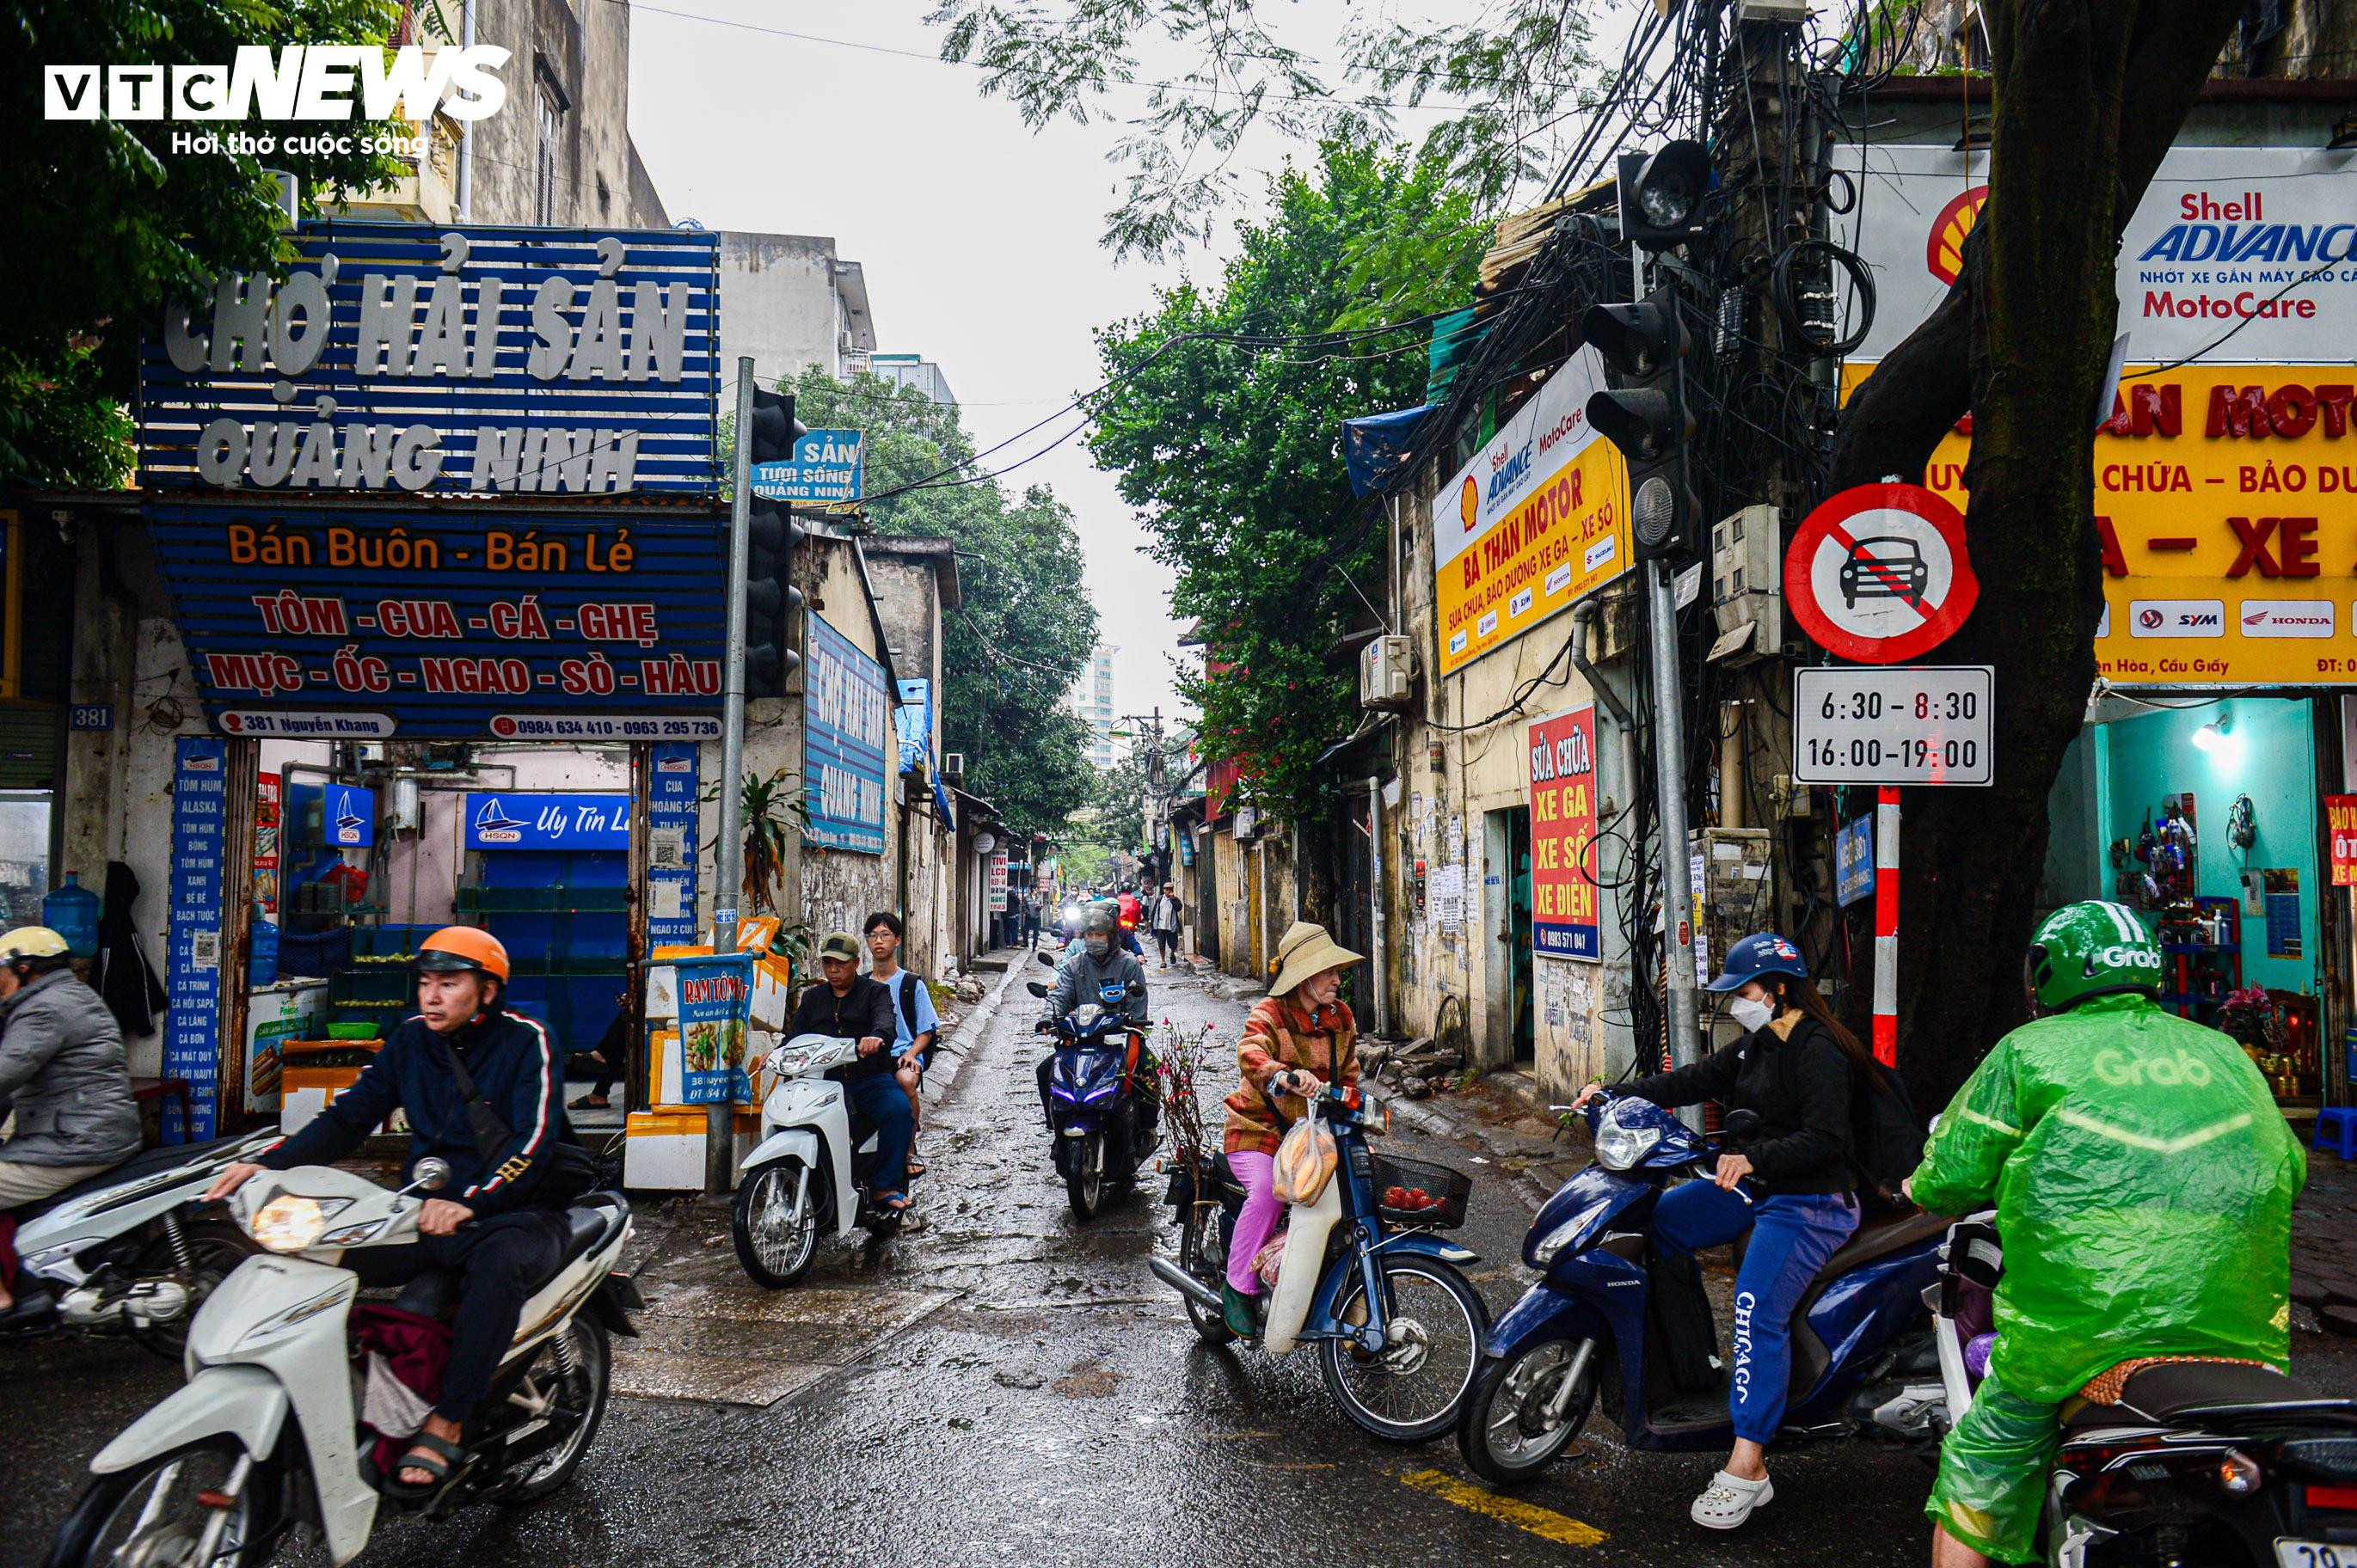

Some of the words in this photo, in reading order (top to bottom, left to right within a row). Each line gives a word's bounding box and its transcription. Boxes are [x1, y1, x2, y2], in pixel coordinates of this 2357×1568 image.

[2179, 192, 2263, 222] Shell
[2140, 267, 2185, 284] NHỚT
[2191, 271, 2211, 284] XE
[2215, 266, 2256, 284] GẮN
[2259, 267, 2295, 284] MÁY
[2301, 270, 2331, 283] CAO
[2143, 291, 2317, 319] MotoCare
[163, 252, 340, 402] CHỢ
[356, 233, 503, 378] HẢI
[526, 237, 689, 383] SẢN
[2205, 383, 2357, 438] MOT
[1538, 407, 1582, 457] MotoCare
[196, 395, 443, 490] QUẢNG
[471, 426, 641, 492] NINH
[804, 436, 856, 463] SẢN
[1492, 441, 1508, 472] Shell
[1487, 439, 1532, 505] ADVANCE
[2102, 460, 2192, 493] CHỮA
[2239, 460, 2308, 493] BẢO
[754, 483, 809, 497] QUẢNG
[814, 487, 855, 497] NINH
[1464, 543, 1481, 590] BÁ
[1483, 517, 1520, 575] THÂN
[1525, 468, 1583, 547] MOTOR
[1539, 545, 1551, 571] XE
[1554, 534, 1568, 561] GA
[1581, 513, 1594, 543] XE
[1598, 493, 1613, 531] SỐ
[228, 524, 310, 565] Bán
[328, 528, 438, 568] Buôn
[487, 531, 566, 572] Bán
[586, 528, 633, 572] Lẻ
[1595, 544, 1614, 560] SUZUKI
[2225, 516, 2320, 578] XE
[1553, 572, 1570, 586] HONDA
[252, 589, 348, 635] TÔM
[377, 600, 463, 638] CUA
[489, 595, 549, 639] CÁ
[578, 603, 658, 647] GHẸ
[2178, 615, 2217, 627] SYM
[2272, 616, 2331, 625] HONDA
[206, 652, 302, 697] MỰC
[333, 645, 390, 692] ỐC
[420, 658, 531, 695] NGAO
[560, 652, 615, 695] SÒ
[641, 653, 721, 695] HÀU
[2159, 658, 2188, 672] Cầu
[2194, 658, 2229, 675] Giấy
[2317, 658, 2342, 672] ĐT:
[819, 650, 844, 747] CHỢ
[844, 654, 863, 740] HẢI
[865, 667, 884, 750] SẢN
[1821, 692, 1881, 720] 6:30
[1914, 692, 1977, 720] 8:30
[76, 708, 107, 727] 381
[244, 715, 274, 731] 381
[281, 715, 332, 733] Nguyễn
[336, 719, 379, 733] Khang
[518, 720, 553, 735] 0984
[556, 721, 582, 735] 634
[587, 721, 612, 735] 410
[623, 721, 658, 735] 0963
[663, 721, 689, 735] 295
[692, 721, 719, 735] 736
[1531, 731, 1555, 783] SỬA
[1556, 724, 1591, 777] CHỮA
[179, 777, 198, 792] TÔM
[200, 777, 221, 792] HÙM
[666, 780, 683, 793] CUA
[820, 748, 857, 821] QUẢNG
[861, 776, 881, 826] NINH
[181, 800, 217, 813] ALASKA
[652, 798, 682, 812] HOÀNG
[1536, 789, 1557, 823] XE
[1563, 784, 1587, 817] GA
[537, 806, 563, 837] Uy
[575, 805, 604, 832] Tín
[2329, 798, 2348, 830] BẢO
[181, 822, 197, 833] TÔM
[199, 821, 215, 833] HÙM
[341, 830, 358, 841] HSQN
[485, 831, 516, 840] HSQN
[1537, 836, 1558, 869] XE
[1564, 823, 1588, 869] SỐ
[181, 857, 195, 868] TÔM
[198, 857, 213, 868] HÙM
[991, 867, 1006, 876] LCD
[187, 875, 206, 885] XANH
[2333, 865, 2346, 882] XE
[1537, 883, 1557, 915] XE
[1557, 879, 1591, 923] ĐIỆN
[176, 910, 195, 923] BẠCH
[651, 925, 671, 934] NGAO
[673, 925, 678, 934] 2
[1547, 930, 1562, 947] 0983
[1562, 931, 1574, 949] 571
[1574, 932, 1586, 950] 041
[179, 944, 188, 956] CÁ
[2103, 946, 2161, 968] Grab
[181, 961, 190, 973] CÁ
[177, 978, 187, 991] CÁ
[189, 978, 210, 991] TRÌNH
[684, 977, 711, 1004] RAM
[711, 971, 740, 1001] TÔM
[171, 996, 181, 1008] CÁ
[196, 998, 214, 1008] SAPA
[177, 1014, 187, 1026] CÁ
[179, 1032, 187, 1044] CÁ
[193, 1069, 212, 1079] NAUY
[2094, 1049, 2212, 1087] Grab
